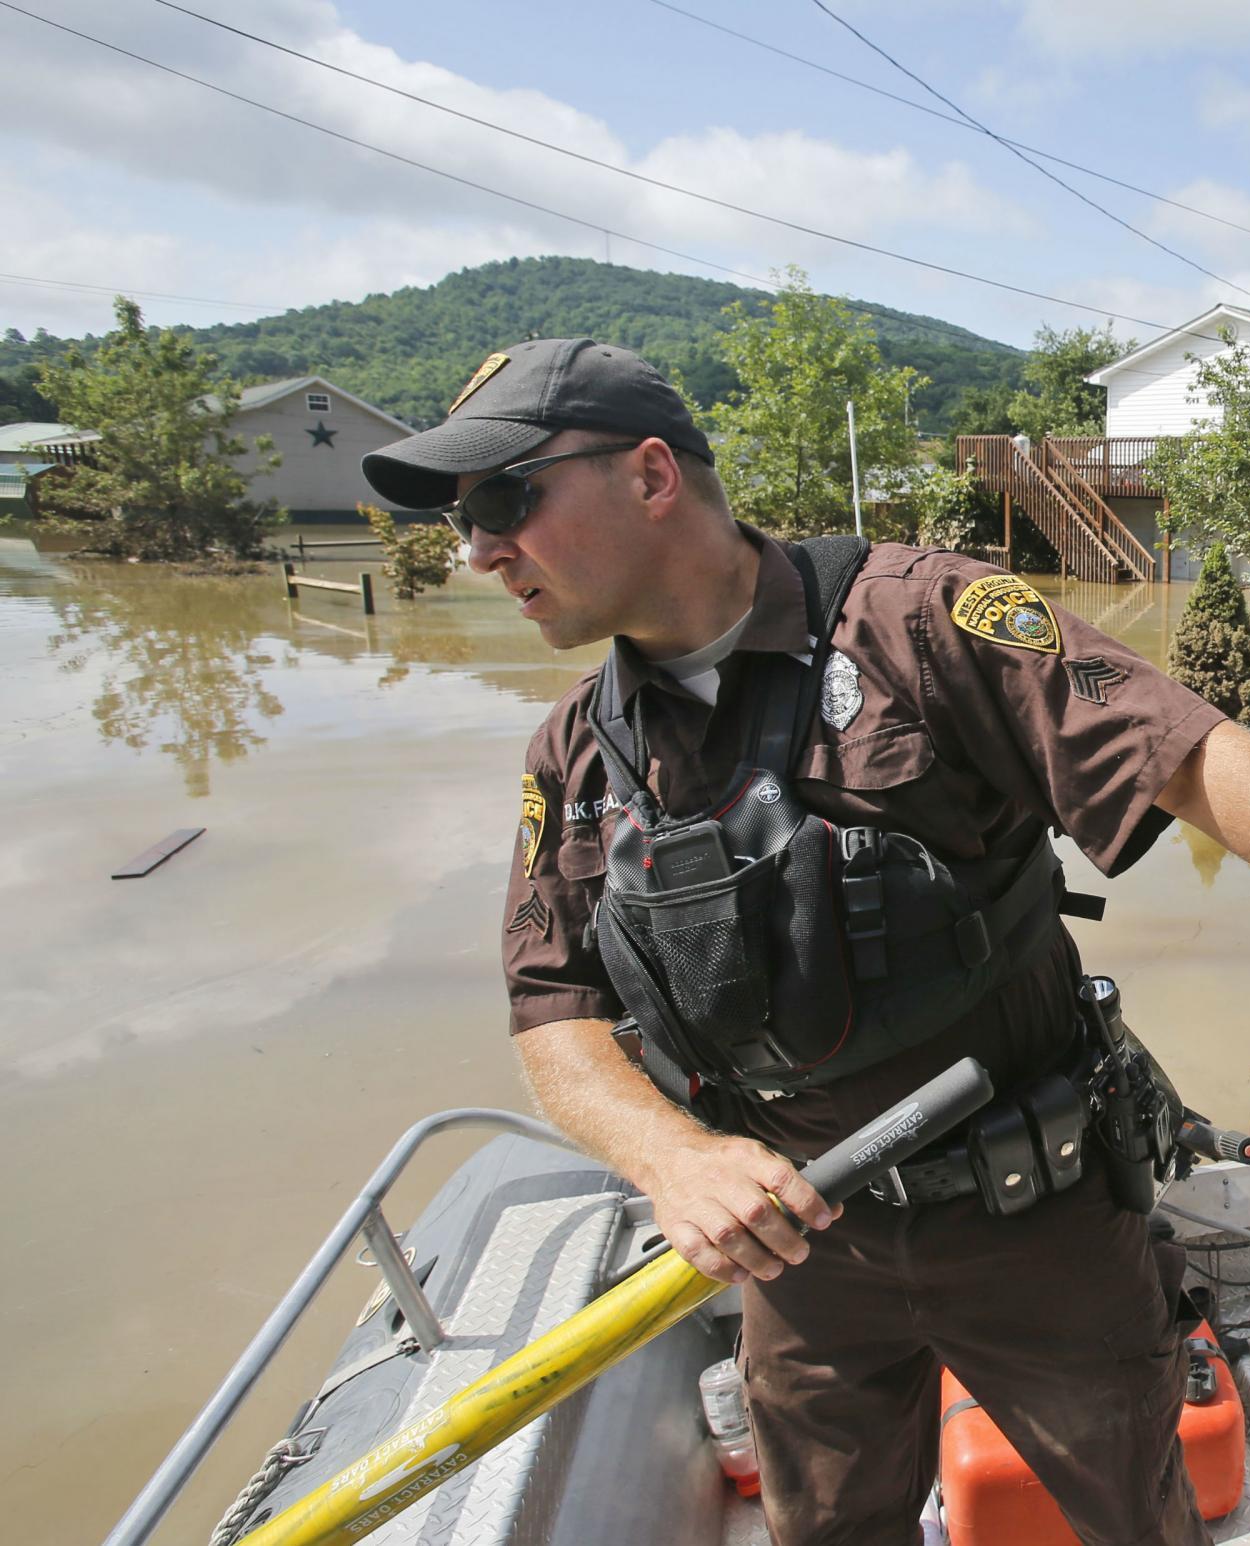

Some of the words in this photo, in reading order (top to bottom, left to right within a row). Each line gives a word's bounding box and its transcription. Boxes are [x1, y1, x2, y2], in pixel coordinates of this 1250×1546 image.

[957, 590, 980, 617] WEST
[968, 597, 992, 627] NATURAL
[977, 590, 1040, 635] POLICE
[852, 1144, 878, 1165] OARS
[330, 1459, 369, 1493] OARS
[350, 1504, 391, 1533] OARS
